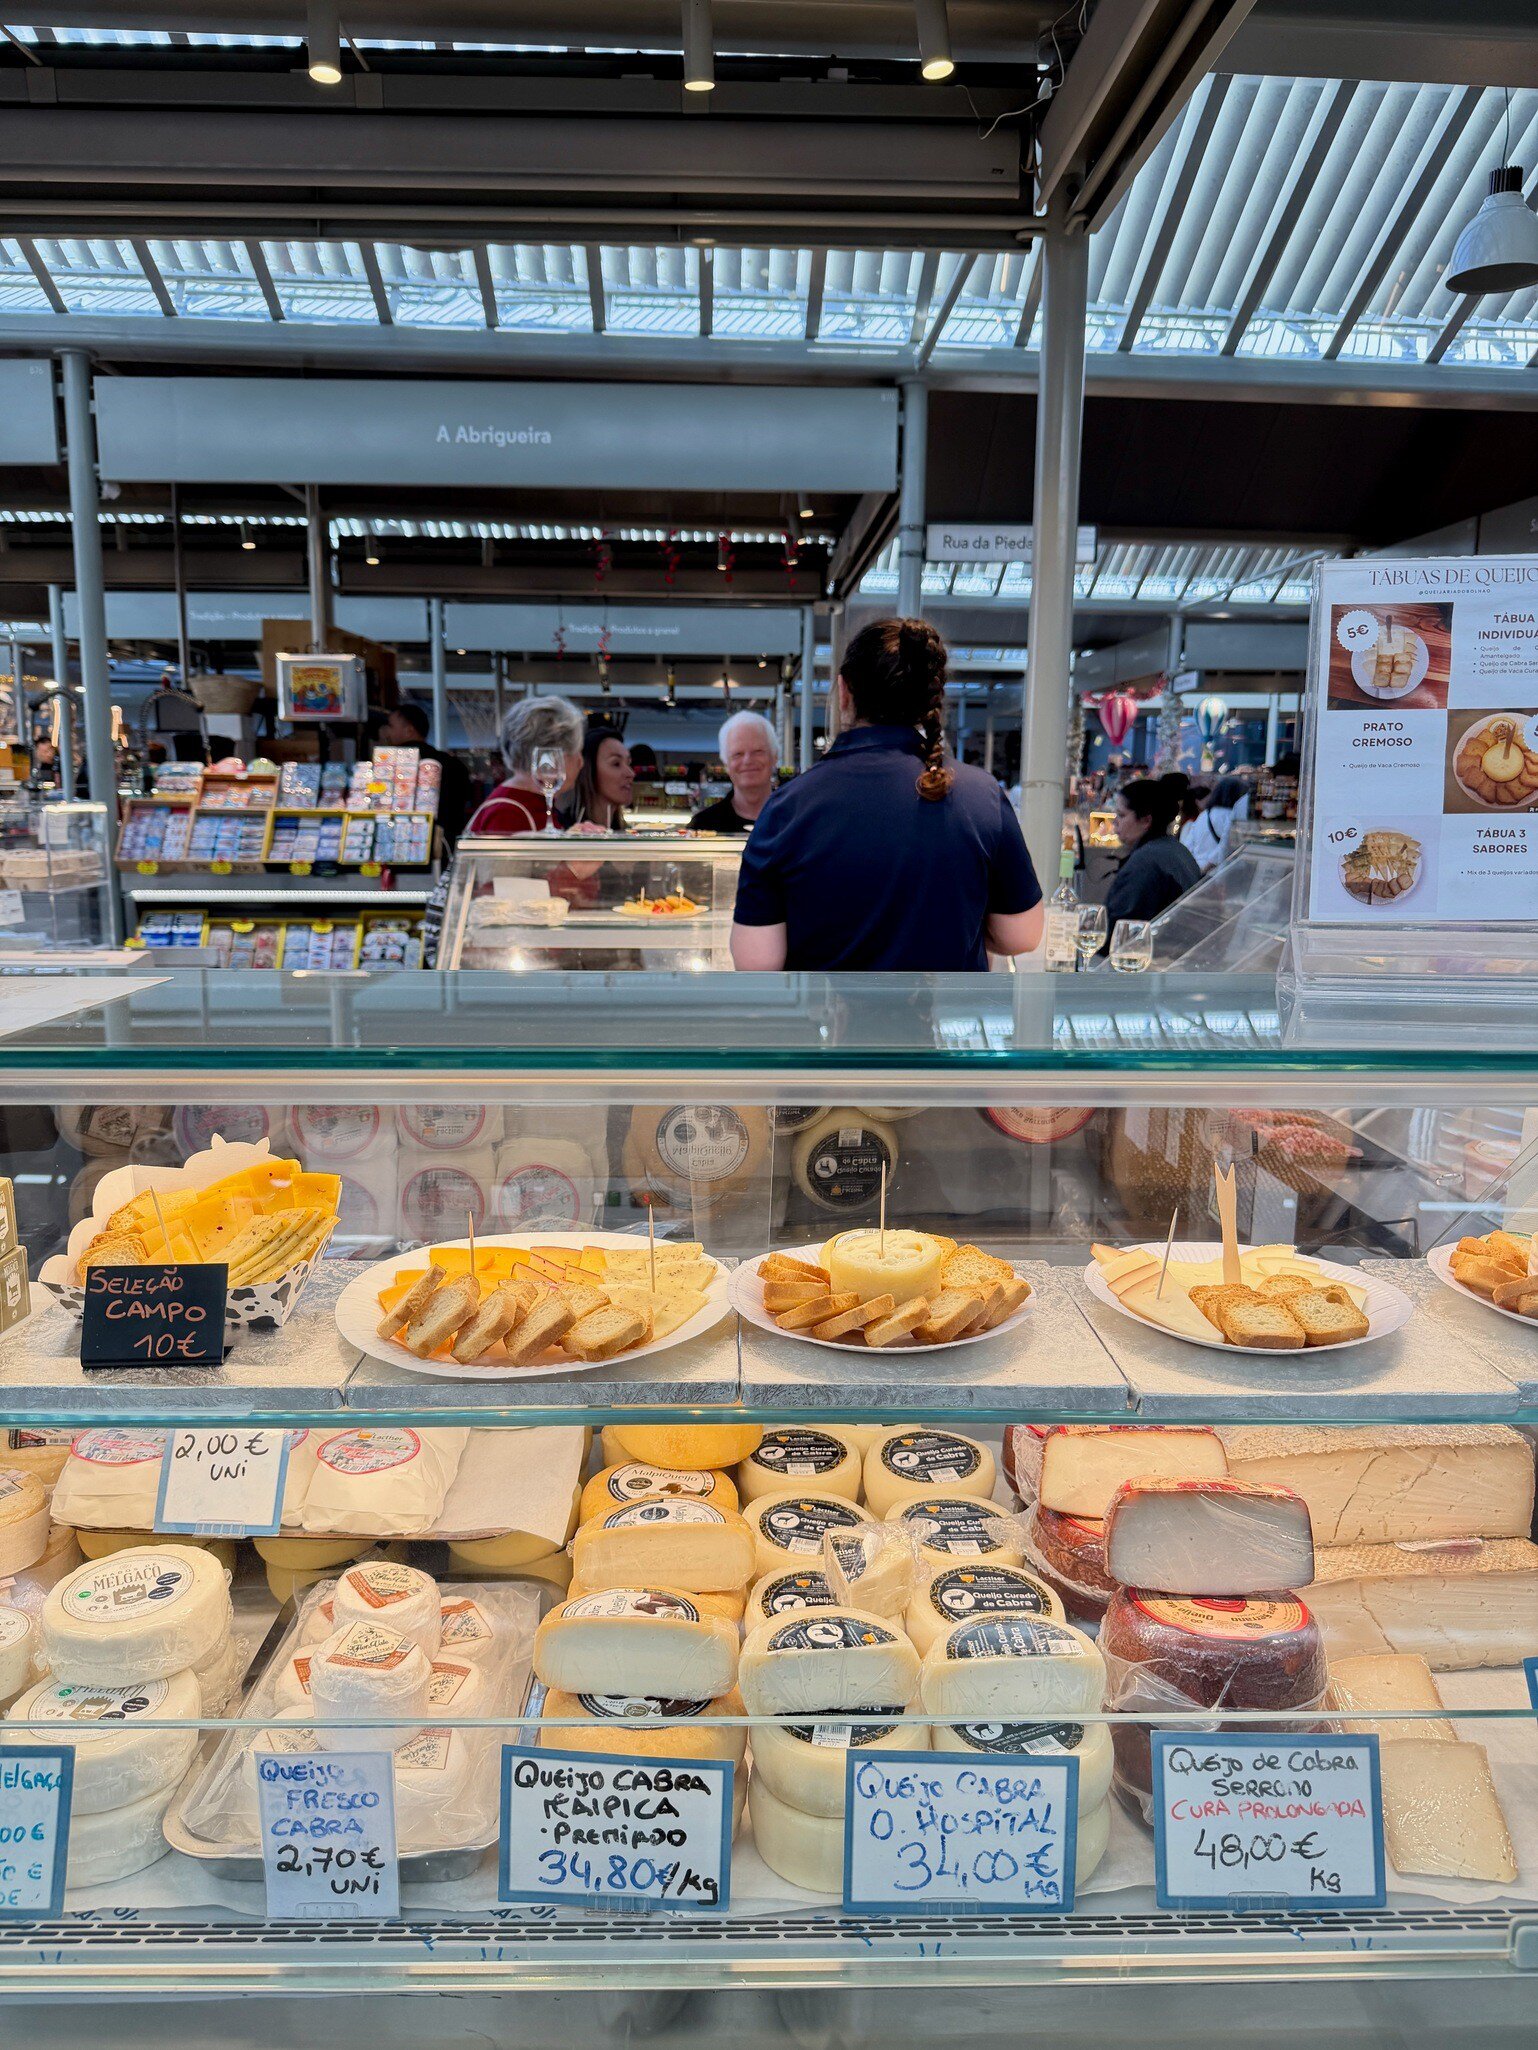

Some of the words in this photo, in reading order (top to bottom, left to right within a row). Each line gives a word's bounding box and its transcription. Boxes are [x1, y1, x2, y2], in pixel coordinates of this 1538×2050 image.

[437, 425, 451, 442] A
[455, 425, 551, 448] Abrigueira
[943, 534, 968, 550] Rua
[972, 535, 989, 550] da
[1369, 567, 1441, 586] TÁBUAS
[1445, 568, 1470, 585] DE
[1493, 611, 1536, 624] TÁBUA
[1347, 624, 1369, 639] 5€
[1363, 722, 1404, 732] PRATO
[1352, 737, 1413, 748] CREMOSO
[1348, 762, 1368, 770] Queijo
[1327, 827, 1358, 844] 10€
[1476, 826, 1516, 838] TÁBUA
[1519, 829, 1526, 838] 3
[1472, 844, 1528, 854] SABORES
[105, 1299, 207, 1323] CAMPO
[133, 1330, 207, 1358] 10€
[936, 1451, 966, 1460] Cabra
[800, 1516, 827, 1526] Queijo
[92, 1564, 162, 1593] MELGAÇO
[805, 1596, 835, 1605] Queijo
[972, 1591, 1003, 1600] Queijo
[1003, 1591, 1037, 1599] Curado
[996, 1599, 1034, 1607] Cabra
[1252, 1752, 1282, 1772] de
[612, 1768, 712, 1796] CABRA
[955, 1770, 1046, 1805] CABRA
[286, 1788, 380, 1810] FRESCO
[1170, 1798, 1231, 1821] CURA
[270, 1816, 364, 1838] CABRA
